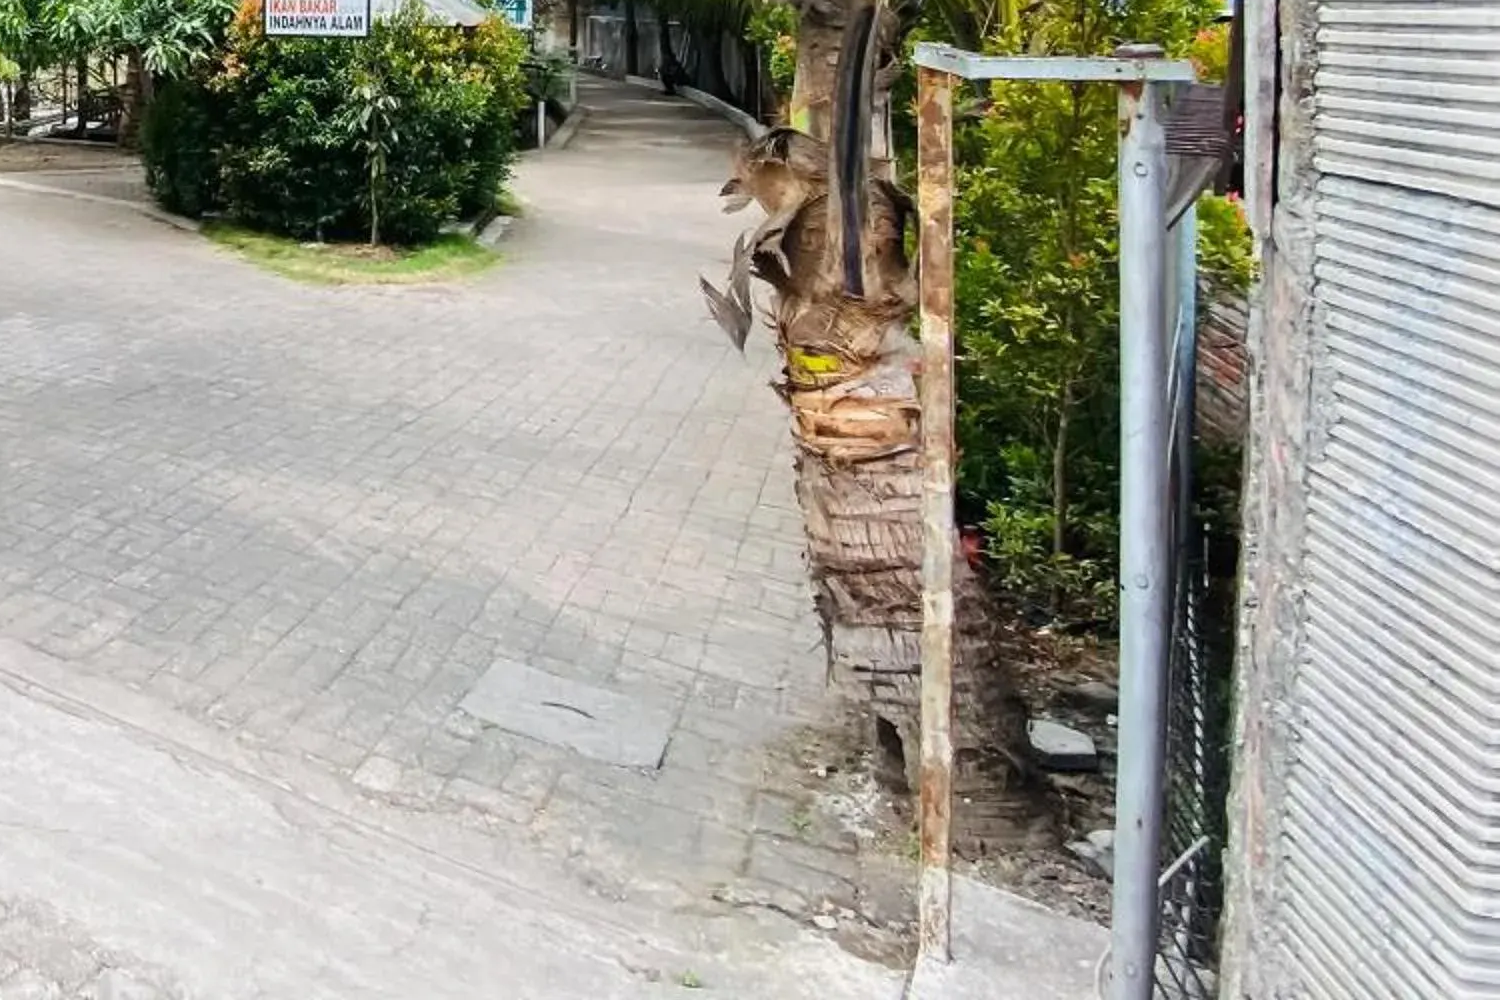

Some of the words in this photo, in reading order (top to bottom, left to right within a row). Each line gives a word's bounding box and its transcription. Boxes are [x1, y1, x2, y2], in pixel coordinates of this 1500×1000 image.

[269, 0, 296, 13] IKAN
[299, 0, 337, 13] BAKAR
[269, 16, 327, 29] INDAHNYA
[331, 16, 363, 30] ALAM
